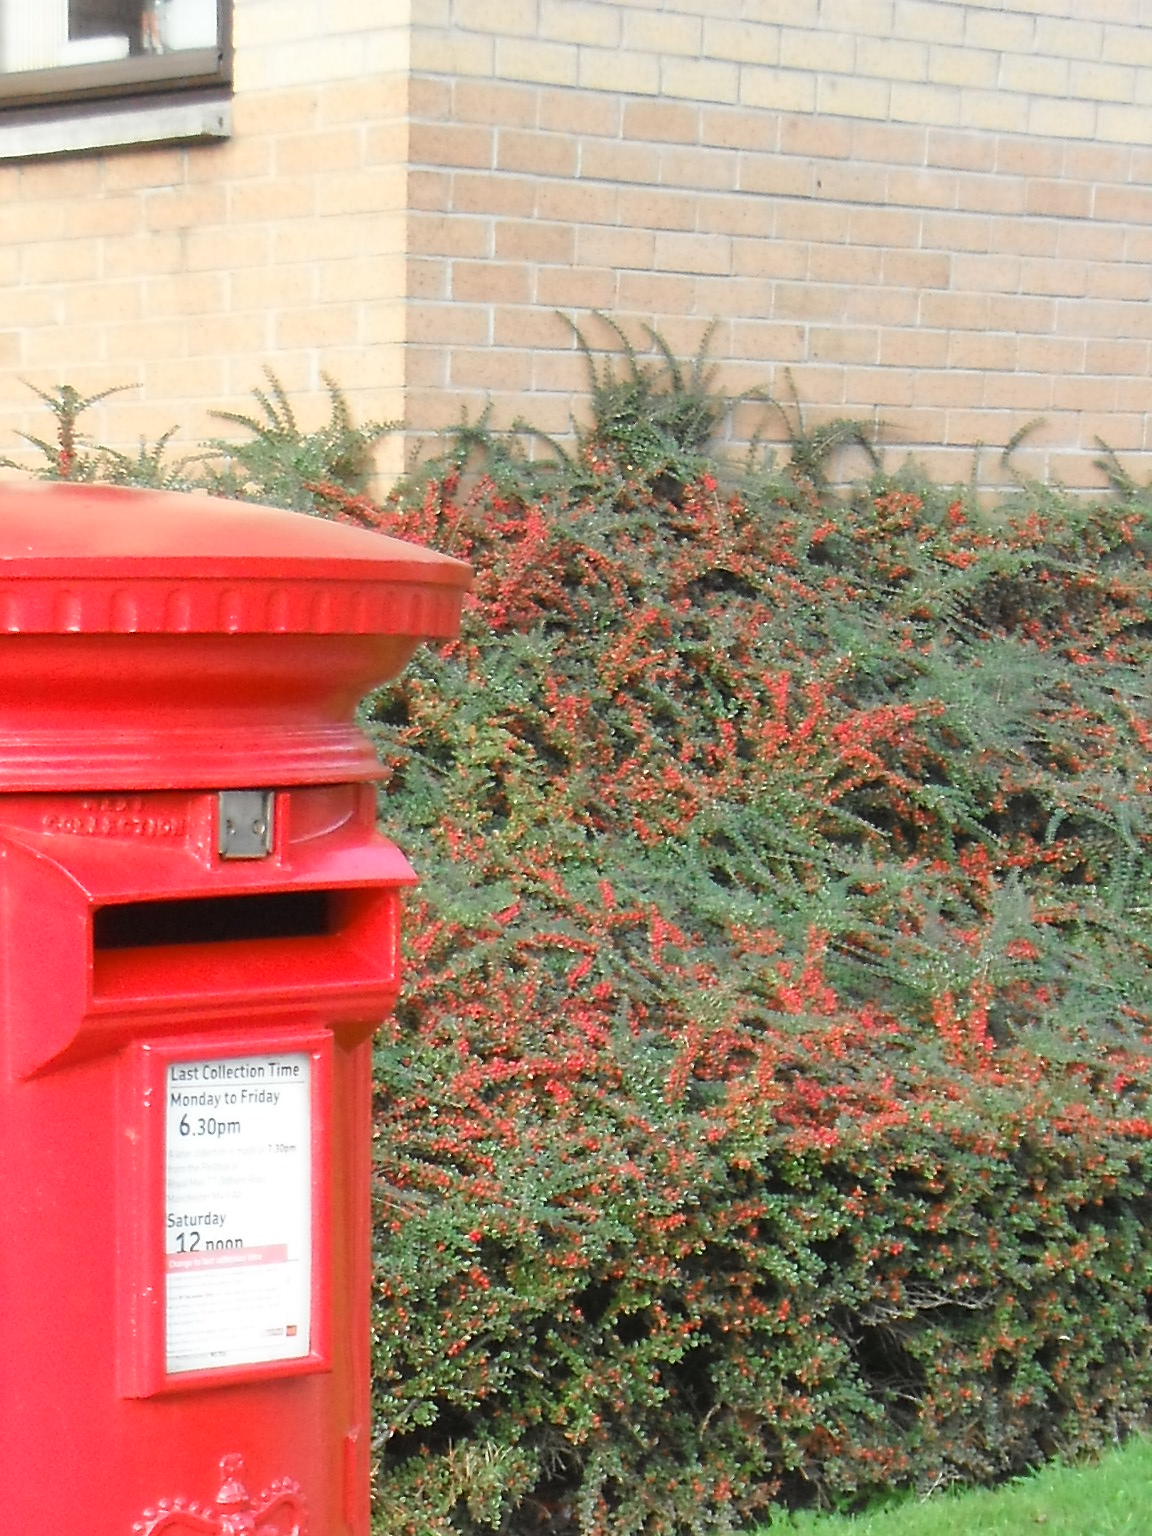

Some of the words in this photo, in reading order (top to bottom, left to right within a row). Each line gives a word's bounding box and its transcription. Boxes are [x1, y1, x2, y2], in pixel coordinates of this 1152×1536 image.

[171, 1066, 199, 1081] Last
[202, 1064, 265, 1080] Collection
[268, 1062, 300, 1077] Time
[170, 1092, 221, 1108] Monday
[224, 1092, 237, 1105] to
[241, 1089, 280, 1106] Friday
[179, 1113, 241, 1138] 6.30pm
[167, 1212, 226, 1228] Saturday
[175, 1231, 201, 1254] 12
[205, 1238, 243, 1251] noon
